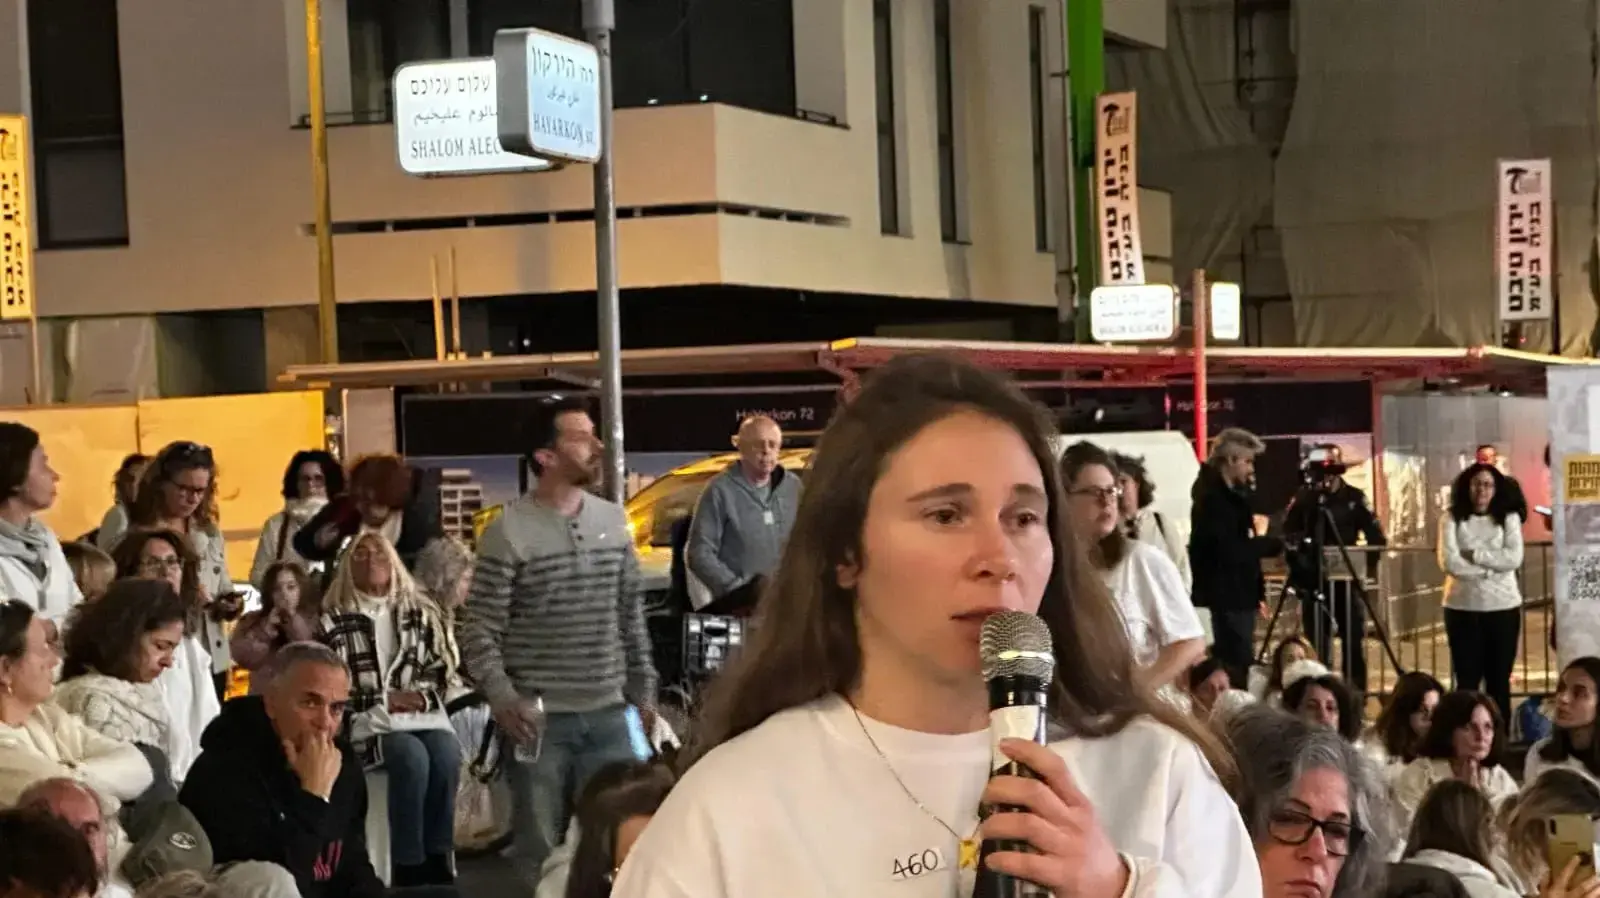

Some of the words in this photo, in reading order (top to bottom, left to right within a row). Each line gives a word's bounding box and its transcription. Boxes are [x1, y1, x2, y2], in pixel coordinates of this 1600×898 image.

[532, 46, 575, 78] הירקון
[410, 76, 450, 96] עליכם
[457, 73, 490, 98] שלום
[533, 113, 584, 148] HAYARKON
[410, 139, 465, 160] SHALOM
[1104, 148, 1121, 198] ירון
[1509, 203, 1528, 244] ירון
[1509, 252, 1524, 313] טיבט
[892, 849, 938, 879] 460
